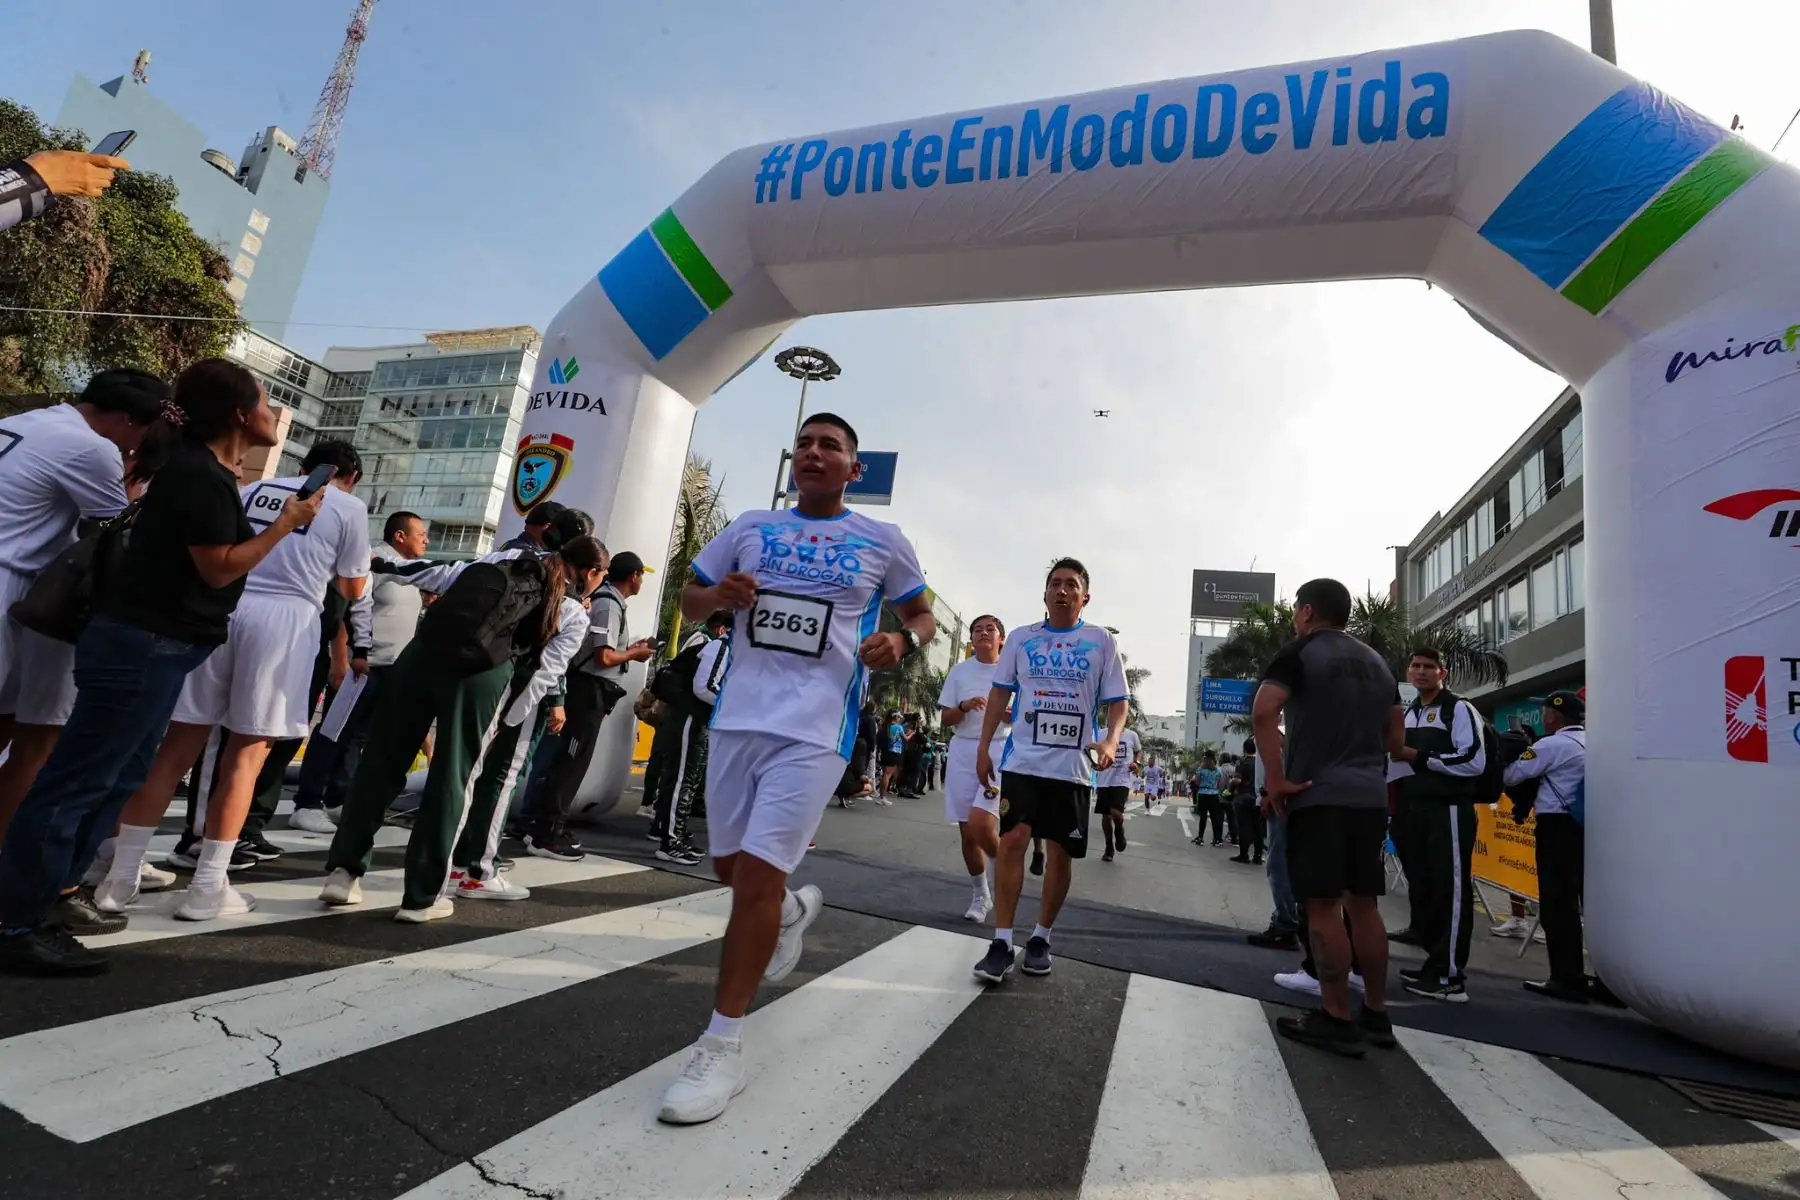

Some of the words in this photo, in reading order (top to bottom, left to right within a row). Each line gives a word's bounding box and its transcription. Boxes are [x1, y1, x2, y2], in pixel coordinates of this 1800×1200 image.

[755, 61, 1450, 204] #PonteEnModoDeVida
[759, 557, 783, 572] SIN
[786, 562, 855, 587] DROGAS
[755, 609, 818, 636] 2563
[1029, 667, 1044, 677] SIN
[1046, 668, 1088, 680] DROGAS
[1205, 680, 1222, 689] LIMA
[1205, 692, 1242, 703] SURQUILLO
[1043, 700, 1080, 712] DEVIDA
[1040, 722, 1078, 737] 1158
